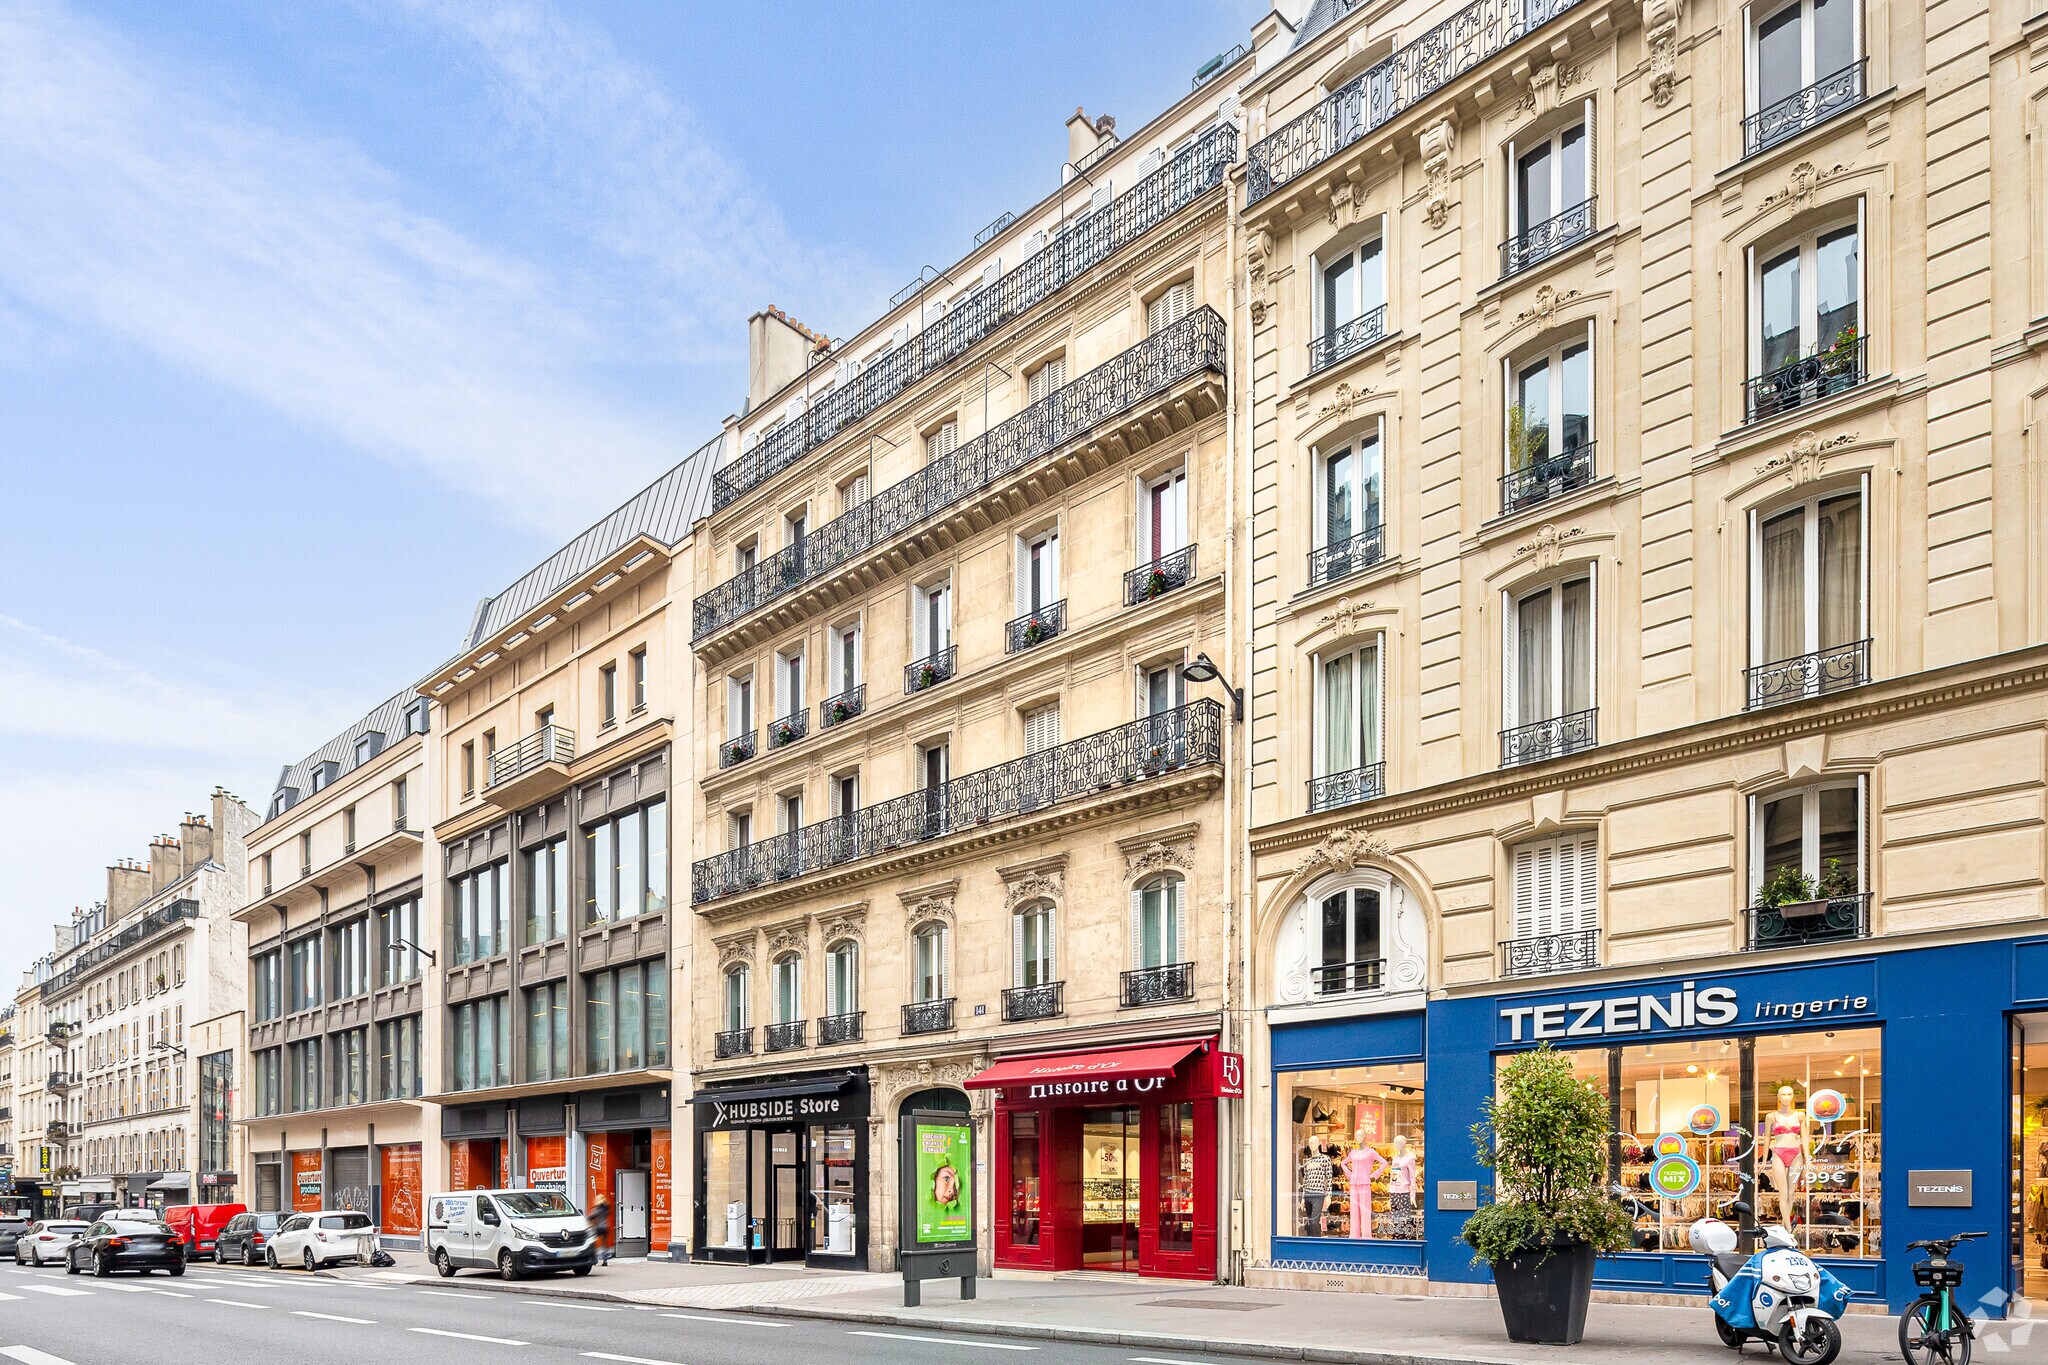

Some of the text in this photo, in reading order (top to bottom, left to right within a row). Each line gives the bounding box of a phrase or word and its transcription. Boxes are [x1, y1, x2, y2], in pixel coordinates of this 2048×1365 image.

[1755, 995, 1868, 1019] lingerie
[1029, 1063, 1085, 1074] Histoire
[730, 1098, 839, 1119] HUBSIDE Store
[1789, 1171, 1847, 1186] 7,99€
[300, 1185, 320, 1195] prochaine
[1785, 1257, 1808, 1267] 2320
